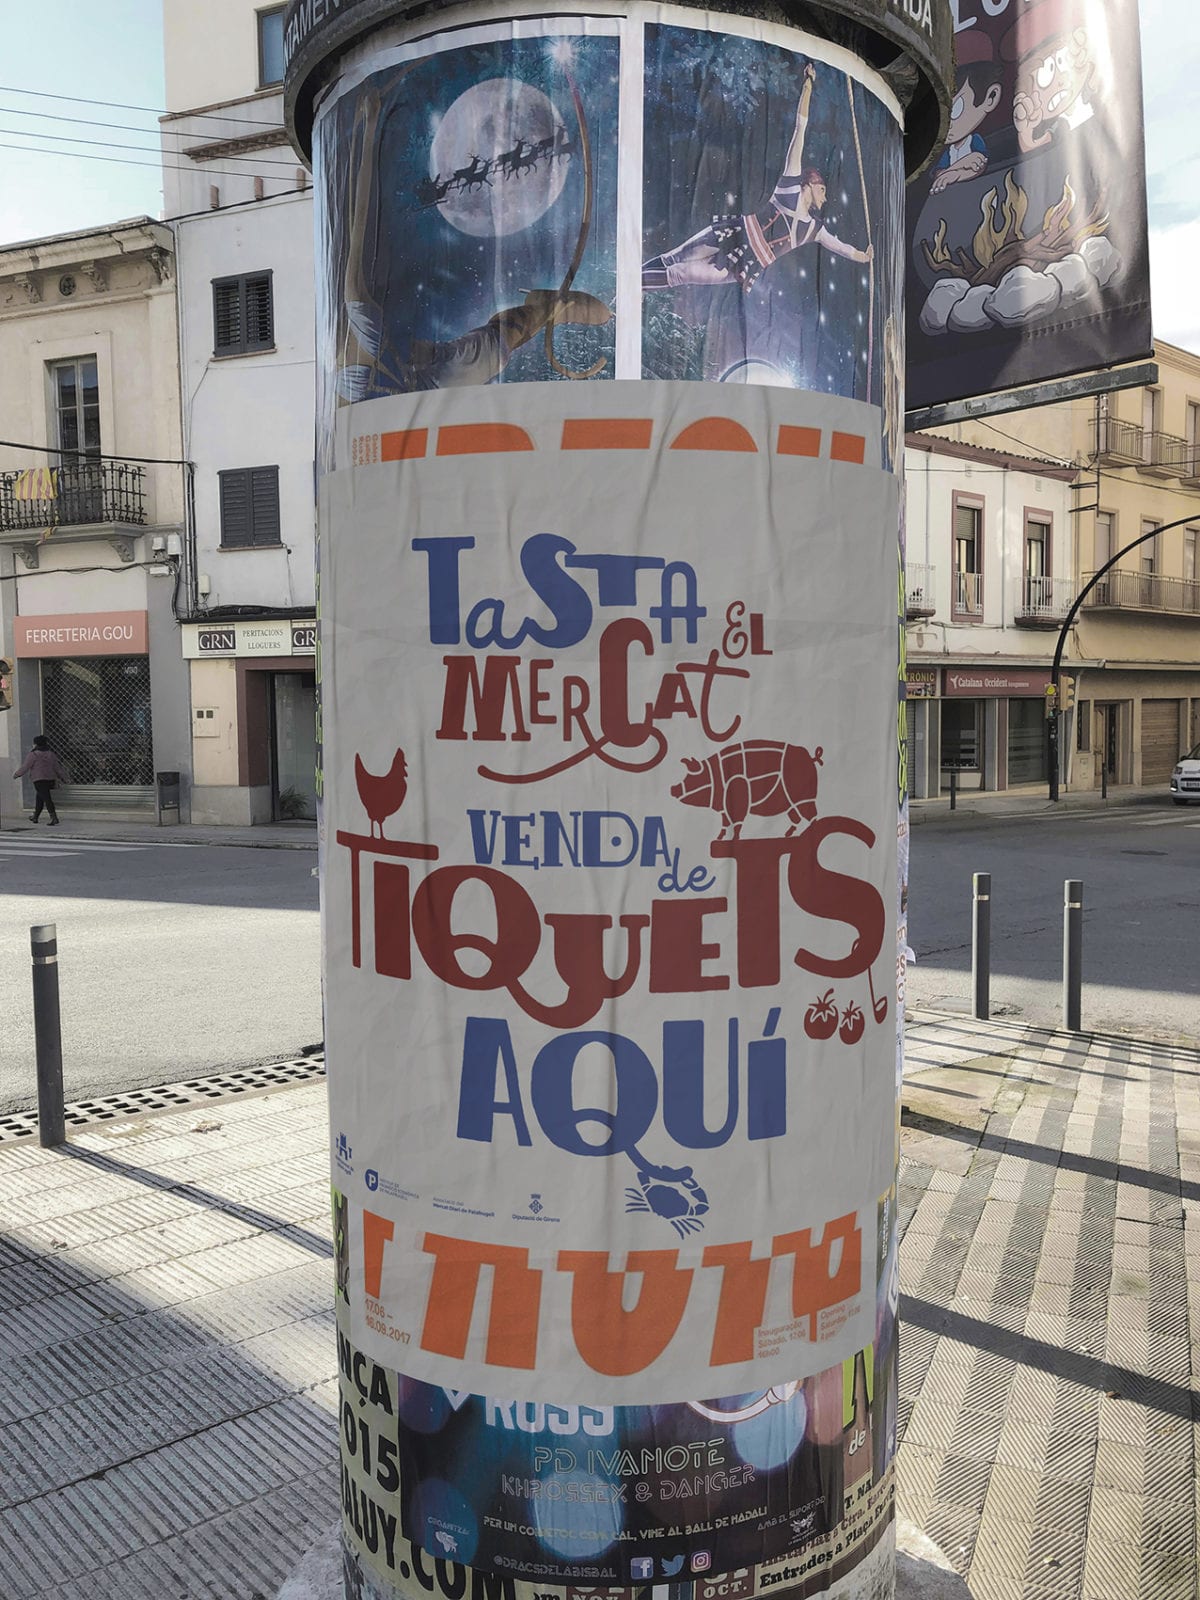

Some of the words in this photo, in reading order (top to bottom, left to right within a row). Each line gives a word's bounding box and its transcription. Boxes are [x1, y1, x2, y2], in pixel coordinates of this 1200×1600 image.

[26, 626, 100, 644] FERRETERIA
[103, 625, 133, 641] GOU
[199, 632, 235, 650] GRN
[242, 629, 284, 637] PERITACIONS
[722, 600, 773, 659] EL
[958, 677, 983, 688] Catalana
[984, 678, 1008, 688] Occident
[466, 809, 672, 870] VENDA
[658, 847, 716, 893] de
[456, 1007, 787, 1157] AQUÍ
[534, 1447, 577, 1474] PD
[587, 1438, 725, 1476] IVANOTE
[660, 1464, 756, 1500] DANGER
[482, 1515, 502, 1529] PER
[639, 1527, 665, 1541] VINE
[667, 1524, 683, 1537] AL
[685, 1516, 714, 1534] BALL
[715, 1516, 730, 1529] DE
[759, 1550, 834, 1589] Entrades
[703, 1580, 749, 1599] OCT.
